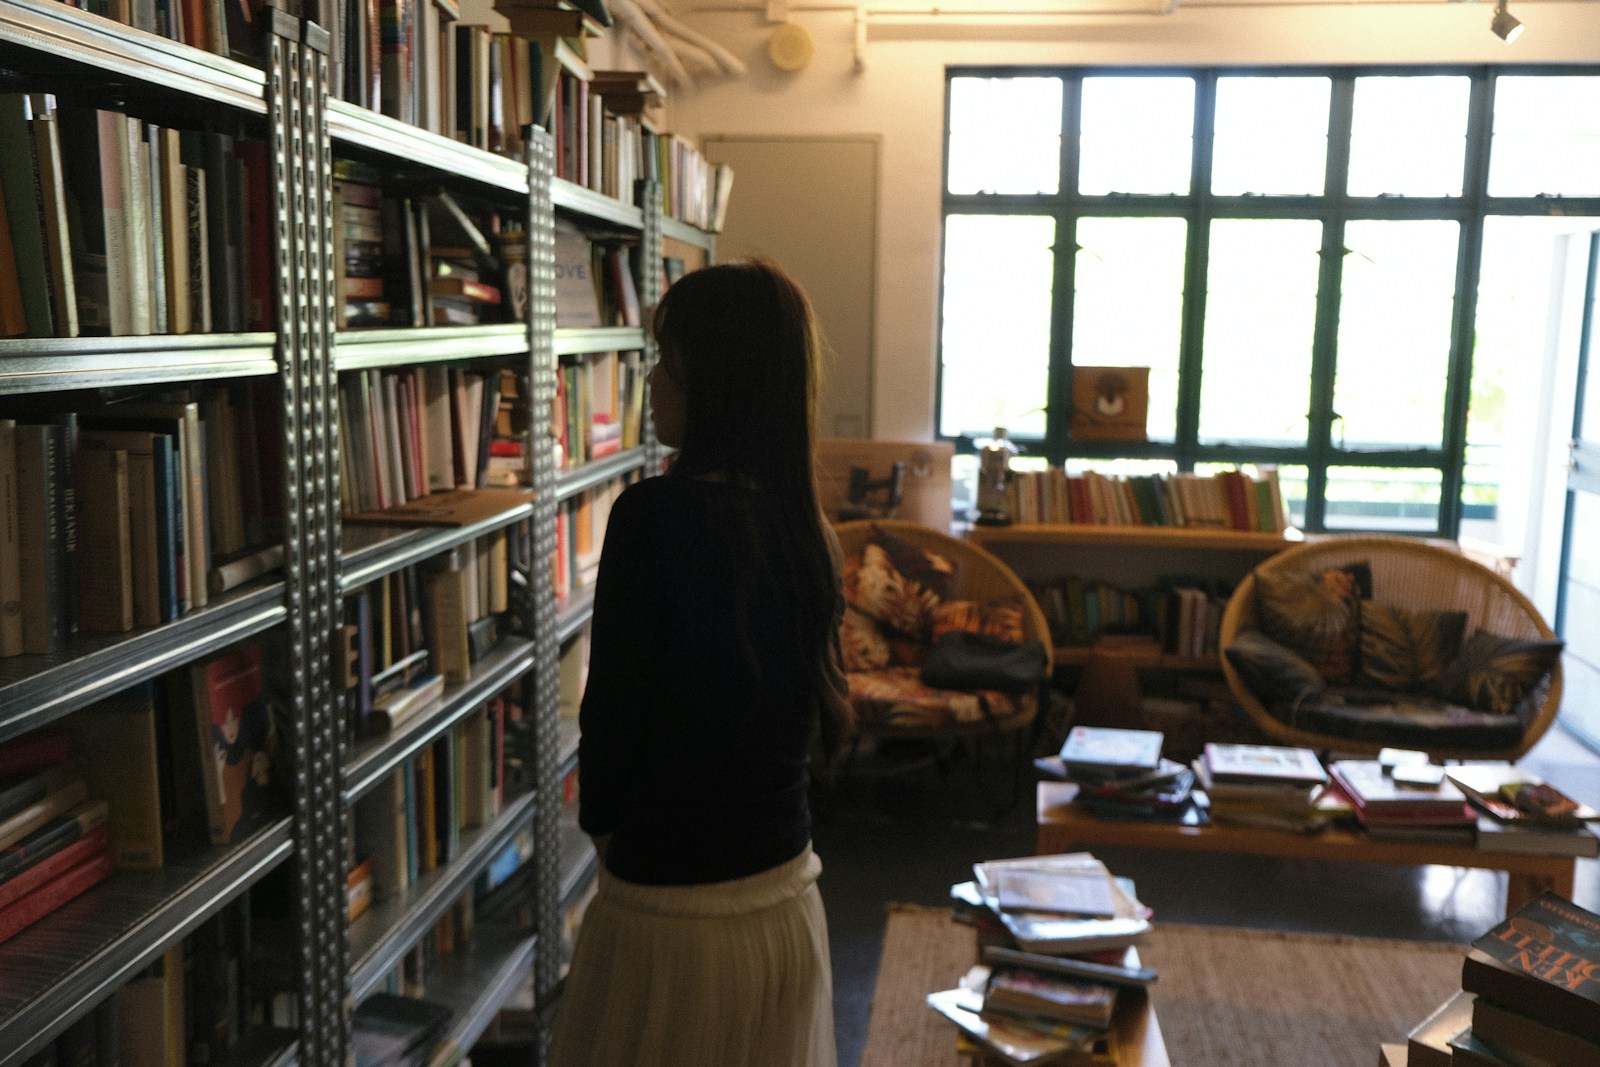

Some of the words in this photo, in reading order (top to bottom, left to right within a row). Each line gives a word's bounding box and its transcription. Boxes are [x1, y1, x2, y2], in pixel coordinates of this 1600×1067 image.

[48, 438, 56, 477] SILVIA
[49, 481, 57, 540] AVALLONE
[63, 488, 76, 554] BENJAMIN
[1507, 950, 1586, 991] KEN
